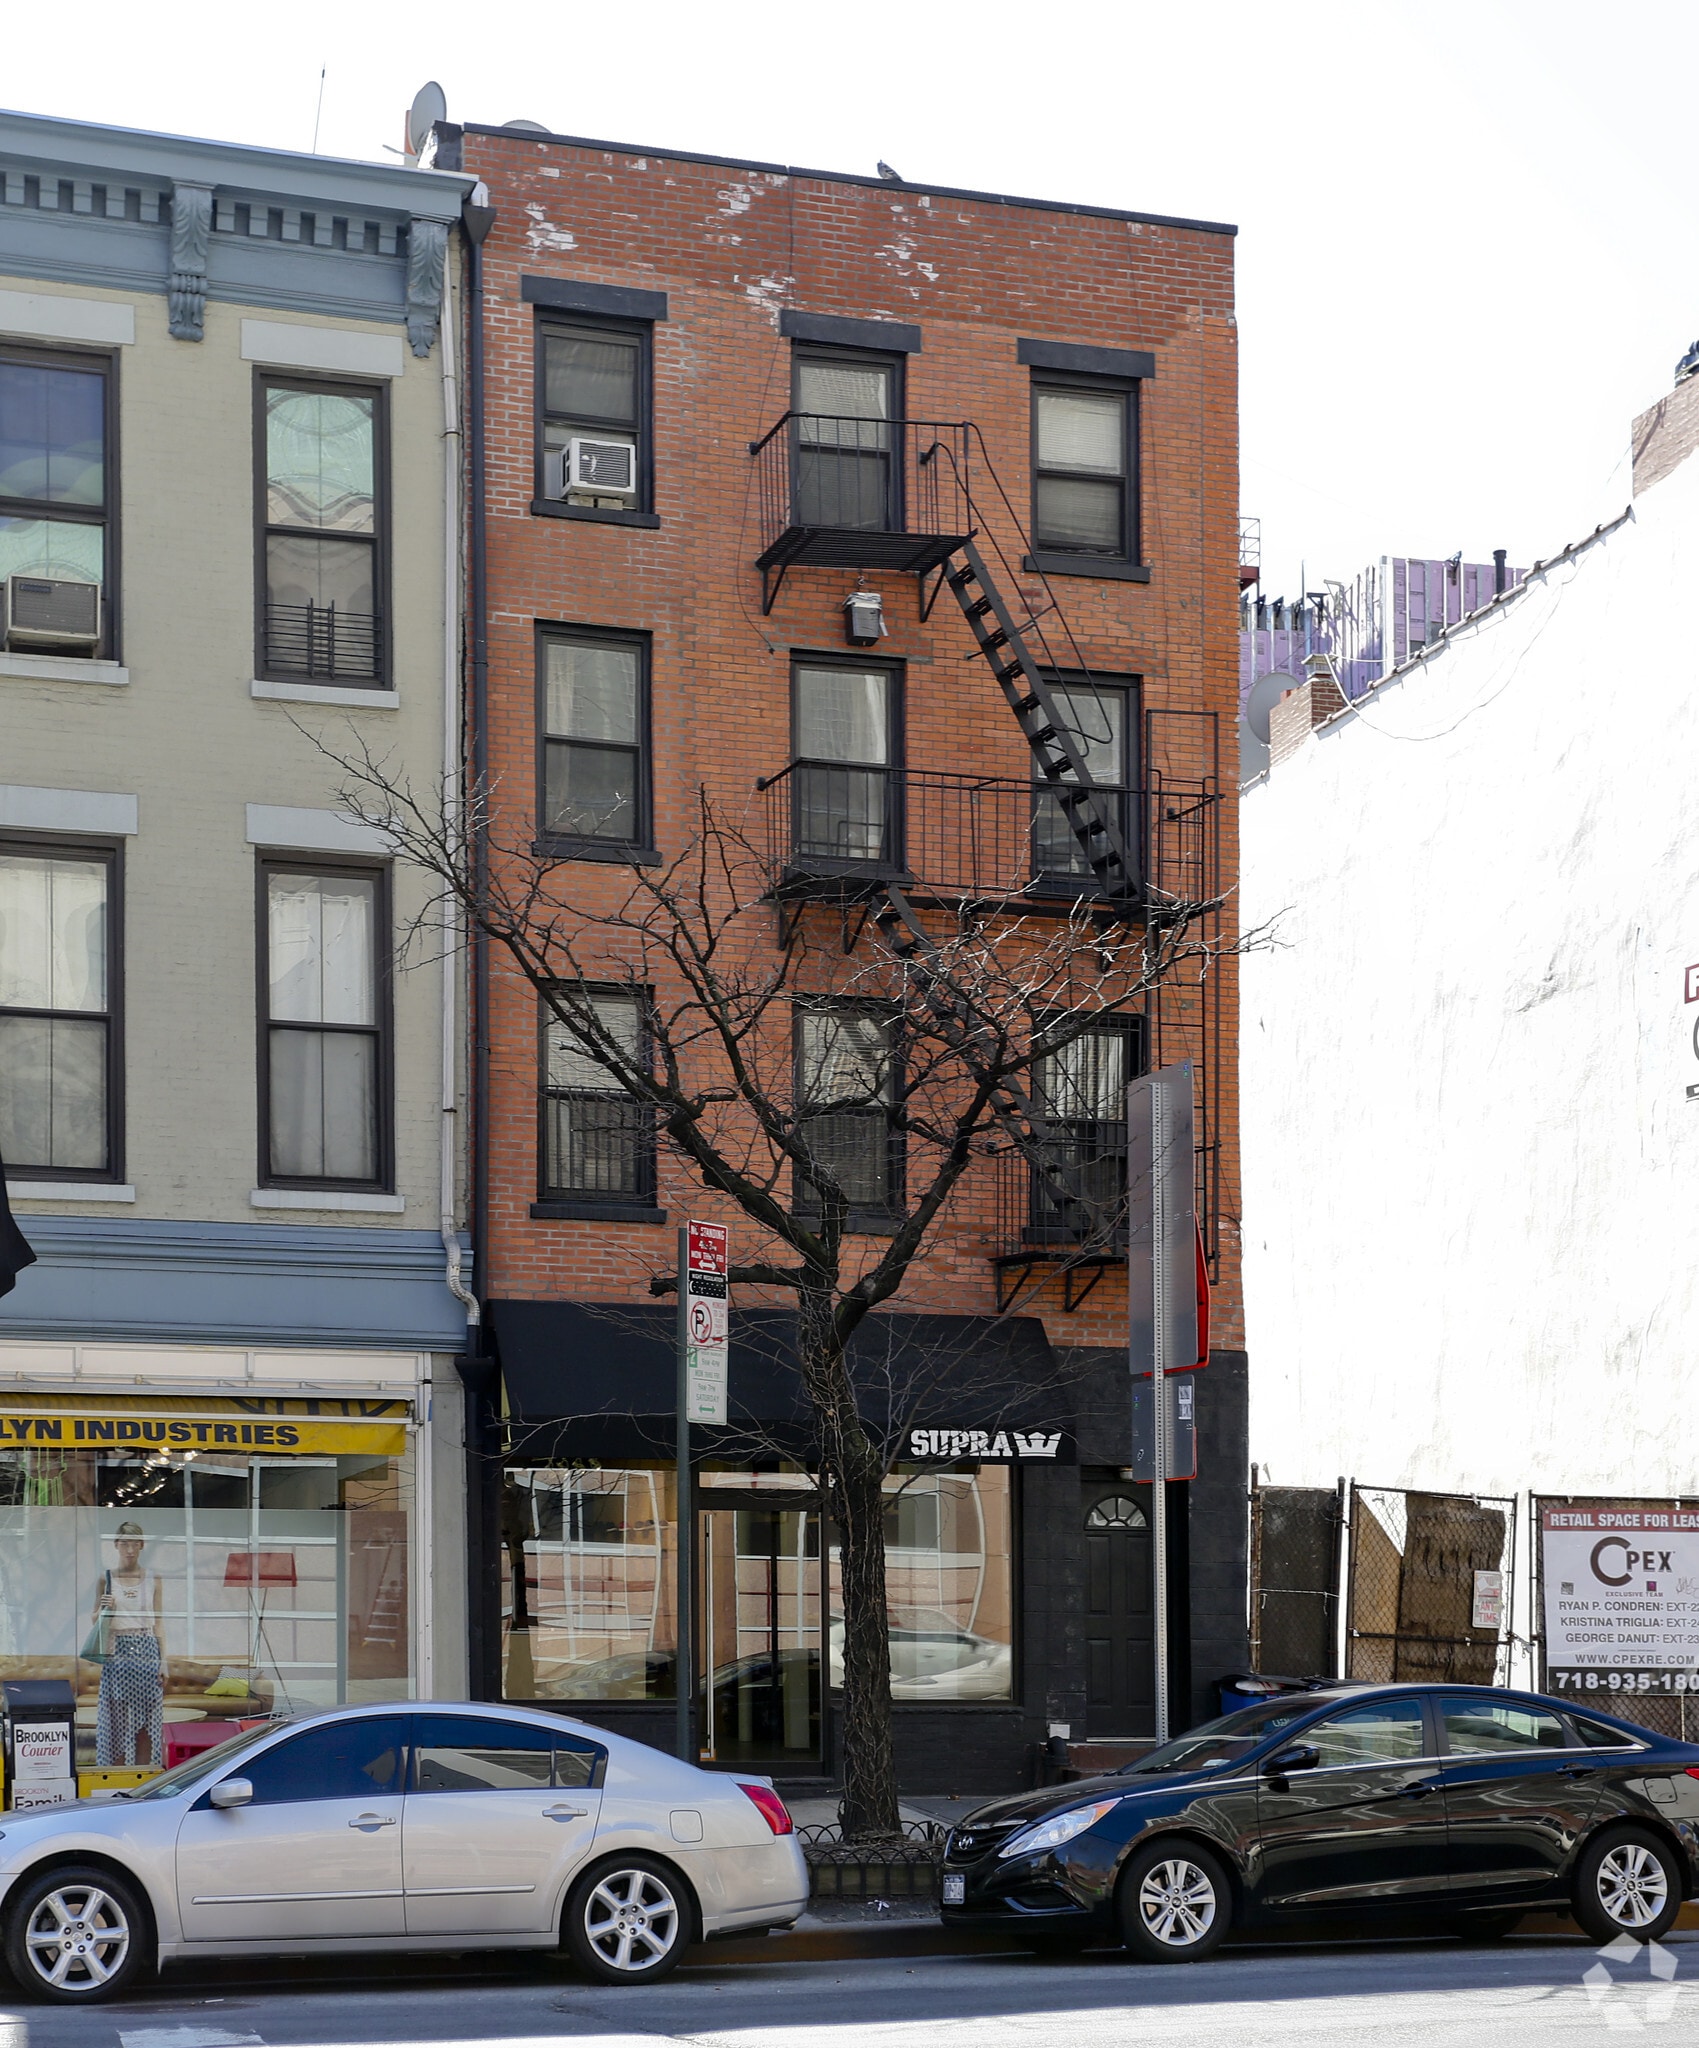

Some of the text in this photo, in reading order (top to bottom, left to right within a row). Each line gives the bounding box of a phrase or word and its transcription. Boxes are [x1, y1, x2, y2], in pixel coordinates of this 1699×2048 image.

[0, 1419, 299, 1446] LYN INDUSTRIES
[910, 1429, 1013, 1457] SUPRA
[1550, 1513, 1595, 1527] RETAIL
[1598, 1514, 1641, 1527] SPACE
[1644, 1515, 1669, 1528] FOR
[1559, 1601, 1589, 1611] RYAN
[1592, 1601, 1601, 1611] P.
[1604, 1601, 1664, 1611] CONDREN:
[1560, 1617, 1613, 1627] KRISTINA
[1616, 1618, 1664, 1627] TRIGLIA:
[1565, 1633, 1614, 1643] GEORGE
[1618, 1634, 1660, 1644] DANUT:
[1575, 1654, 1695, 1665] WWW.CPEXRE.COM
[1556, 1672, 1699, 1690] 718-935-180
[15, 1729, 68, 1743] BROOKLYN
[21, 1743, 64, 1757] Courier
